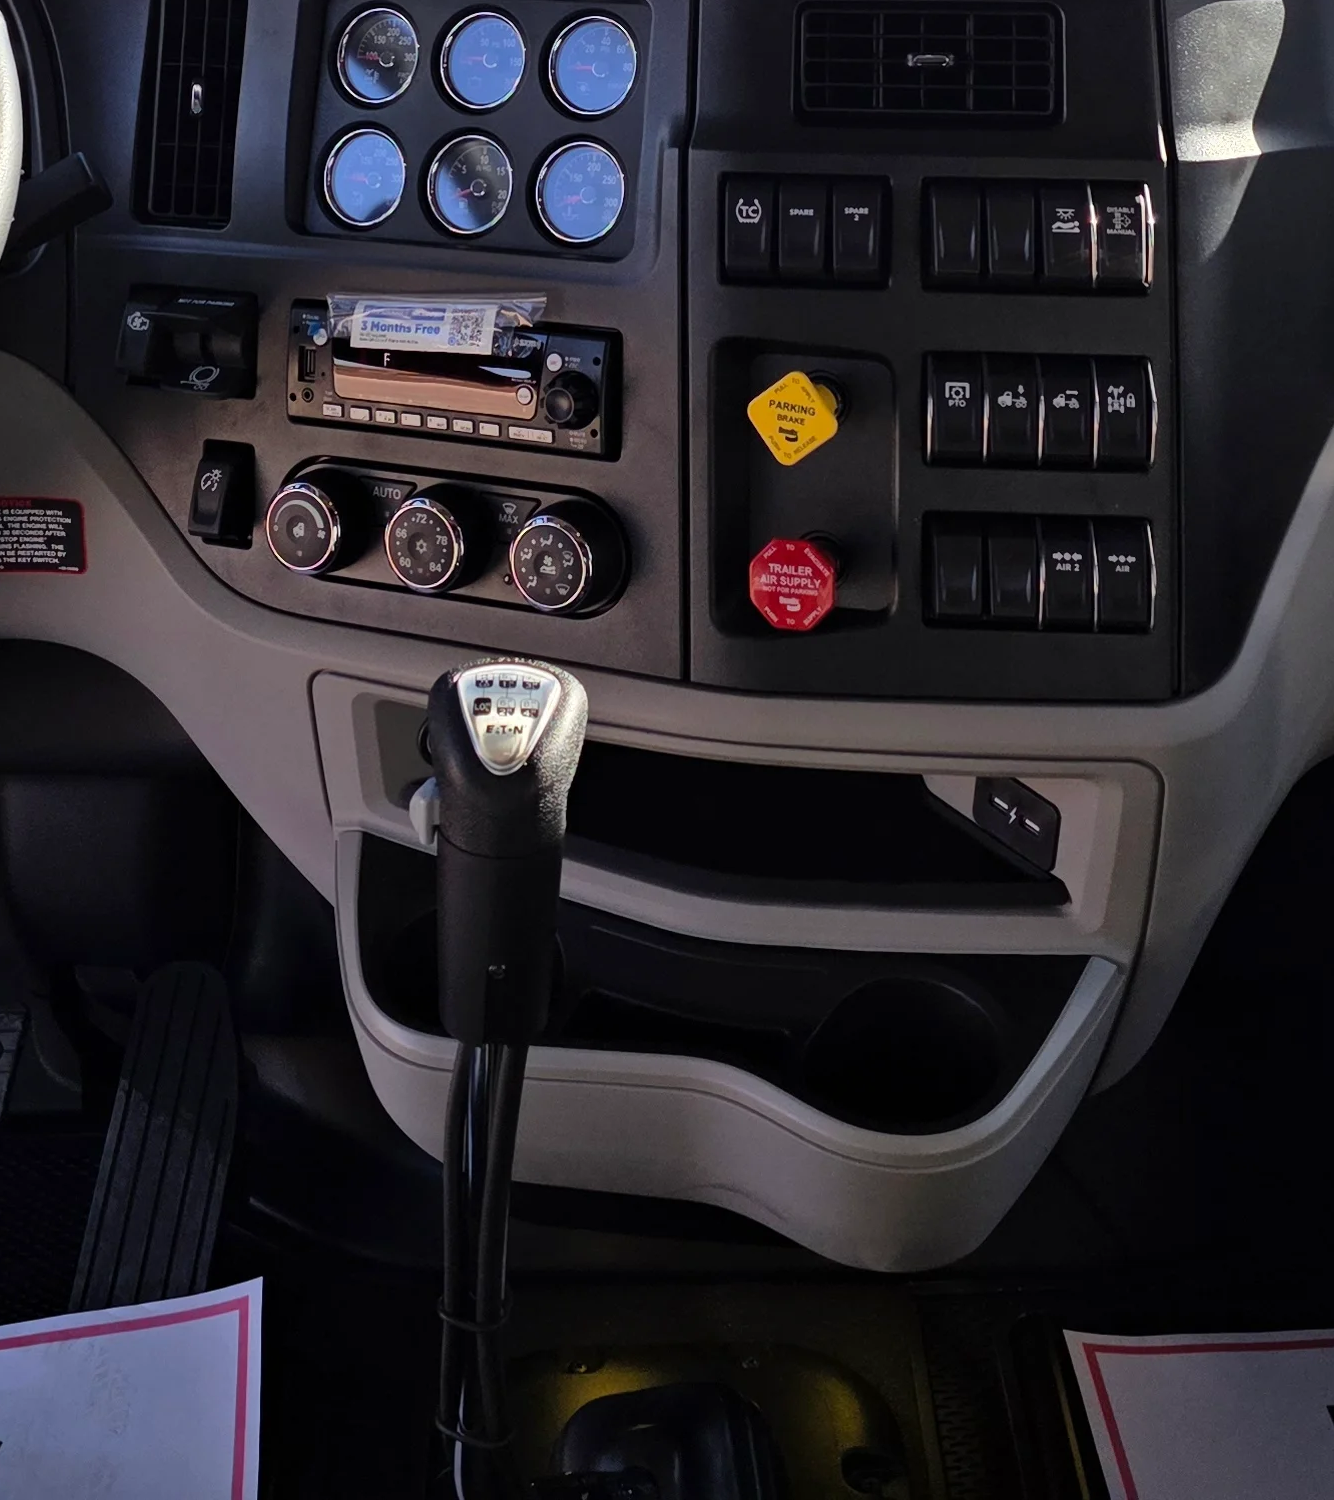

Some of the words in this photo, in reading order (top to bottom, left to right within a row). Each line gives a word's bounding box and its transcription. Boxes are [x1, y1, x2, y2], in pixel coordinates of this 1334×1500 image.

[387, 27, 401, 37] 200
[374, 36, 387, 45] 150
[398, 36, 412, 46] 250
[480, 155, 489, 165] 10
[461, 165, 467, 174] 5
[496, 167, 506, 176] 15
[498, 190, 507, 200] 20
[739, 205, 758, 218] TC
[789, 208, 814, 216] SPARE
[844, 207, 869, 215] SPARE
[1107, 228, 1136, 236] MANUAL
[361, 321, 368, 331] 3
[371, 321, 412, 334] Months
[415, 324, 441, 335] Free
[769, 400, 816, 416] PARKING
[948, 400, 966, 408] PTO
[777, 414, 805, 426] BRAKE
[373, 486, 402, 500] AUTO
[416, 513, 427, 524] 72
[499, 513, 519, 524] MAX
[395, 527, 408, 539] 66
[436, 535, 448, 546] 78
[399, 557, 412, 568] 60
[429, 562, 442, 573] 84
[804, 548, 830, 577] EVACUATE
[1055, 563, 1072, 571] AIR
[1073, 563, 1080, 572] 2
[1115, 564, 1130, 572] AIR
[769, 563, 812, 576] TRAILER
[760, 574, 783, 584] AIR
[785, 576, 820, 588] SUPPLY
